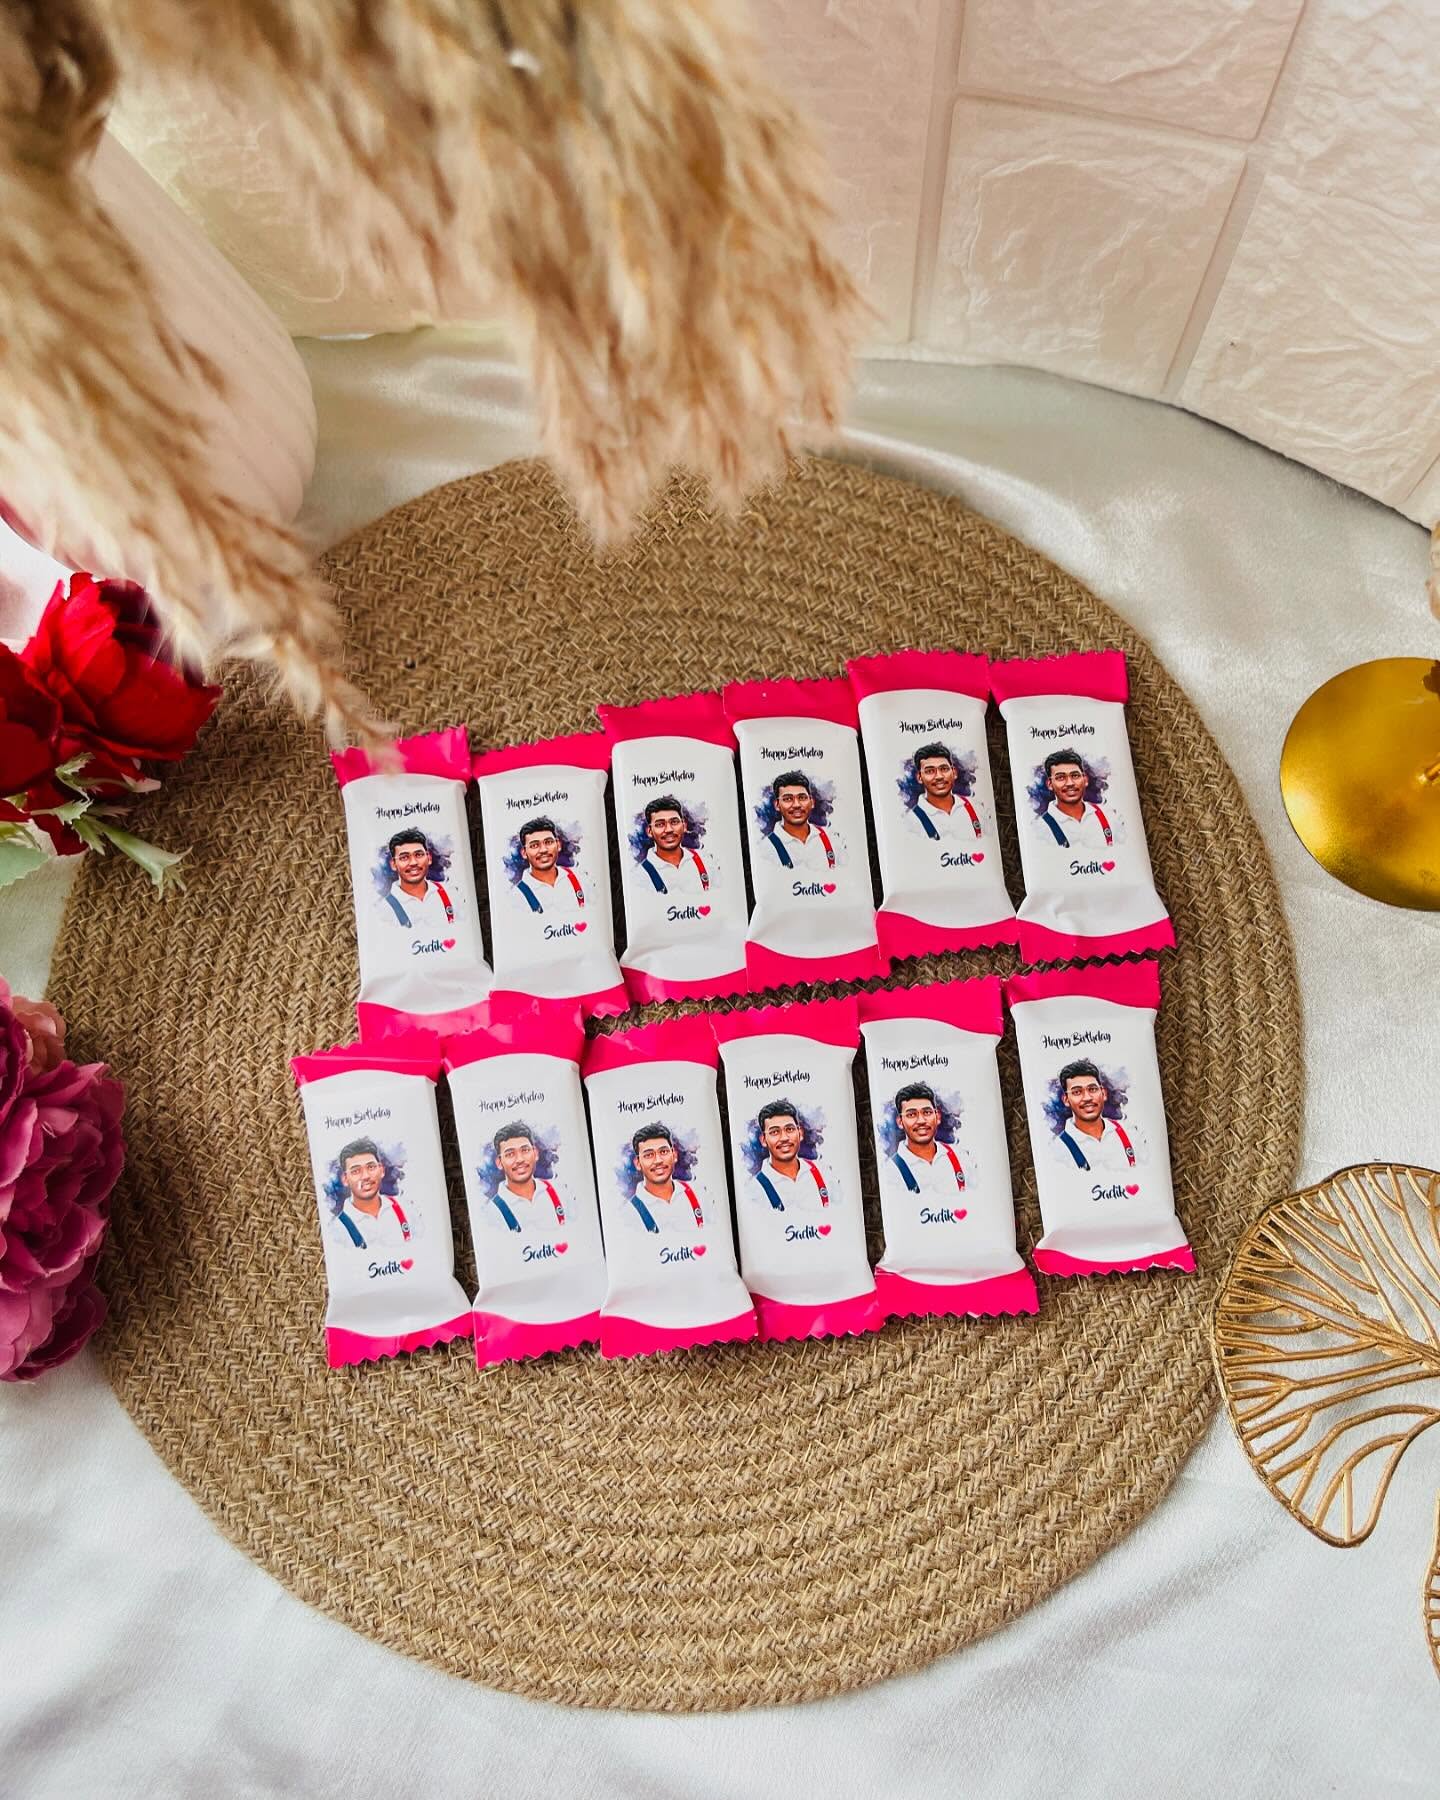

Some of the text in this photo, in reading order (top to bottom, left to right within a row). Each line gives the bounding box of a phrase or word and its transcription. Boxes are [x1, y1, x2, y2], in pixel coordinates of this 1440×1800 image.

[898, 717, 963, 735] Happy Birthday
[1029, 723, 1095, 740] Happy Birthday
[760, 746, 824, 761] Happy Birthday
[631, 769, 695, 788] Happy Birthday
[505, 790, 569, 811] Happy Birthday
[375, 801, 441, 820] Happy Birthday
[940, 851, 975, 868] Sadik
[1069, 859, 1104, 876] Sadik
[792, 880, 826, 897] Sadik
[666, 905, 702, 922] Sadik
[543, 923, 578, 941] Sadik
[411, 939, 446, 956] Sadik
[1042, 1030, 1112, 1050] Happy Birthday
[881, 1053, 949, 1072] Happy Birthday
[743, 1069, 811, 1090] Happy Birthday
[480, 1090, 545, 1113] Happy Birthday
[617, 1092, 685, 1115] Happy Birthday
[324, 1107, 391, 1129] Happy Birthday
[1091, 1184, 1128, 1202] Sadik
[919, 1207, 956, 1225] Sadik
[784, 1224, 820, 1242] Sadik
[522, 1243, 559, 1263] Sadik
[659, 1246, 696, 1265] Sadik
[367, 1260, 403, 1279] Sadik
